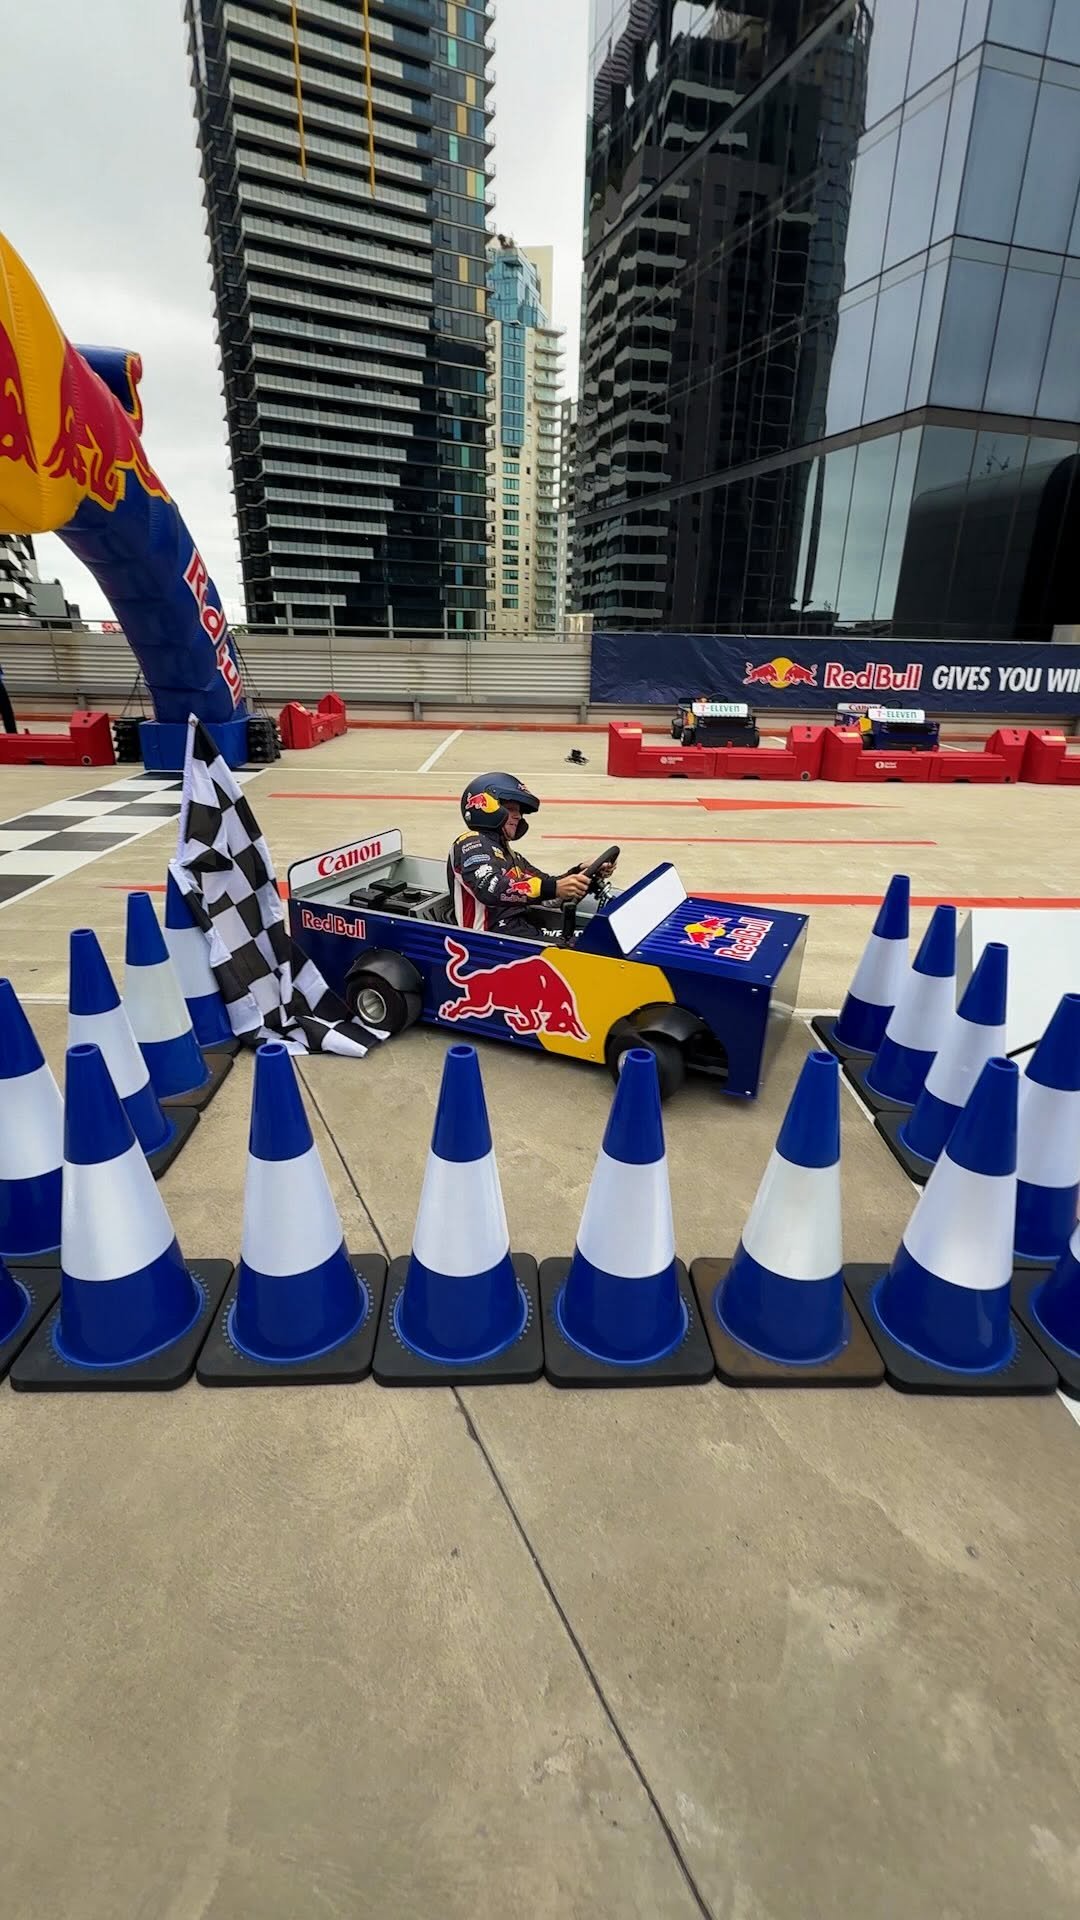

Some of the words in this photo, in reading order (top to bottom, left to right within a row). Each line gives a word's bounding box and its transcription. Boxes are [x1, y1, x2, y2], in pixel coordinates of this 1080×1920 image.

[932, 665, 991, 691] GIVES
[998, 667, 1042, 692] YOU
[317, 840, 382, 877] Canon
